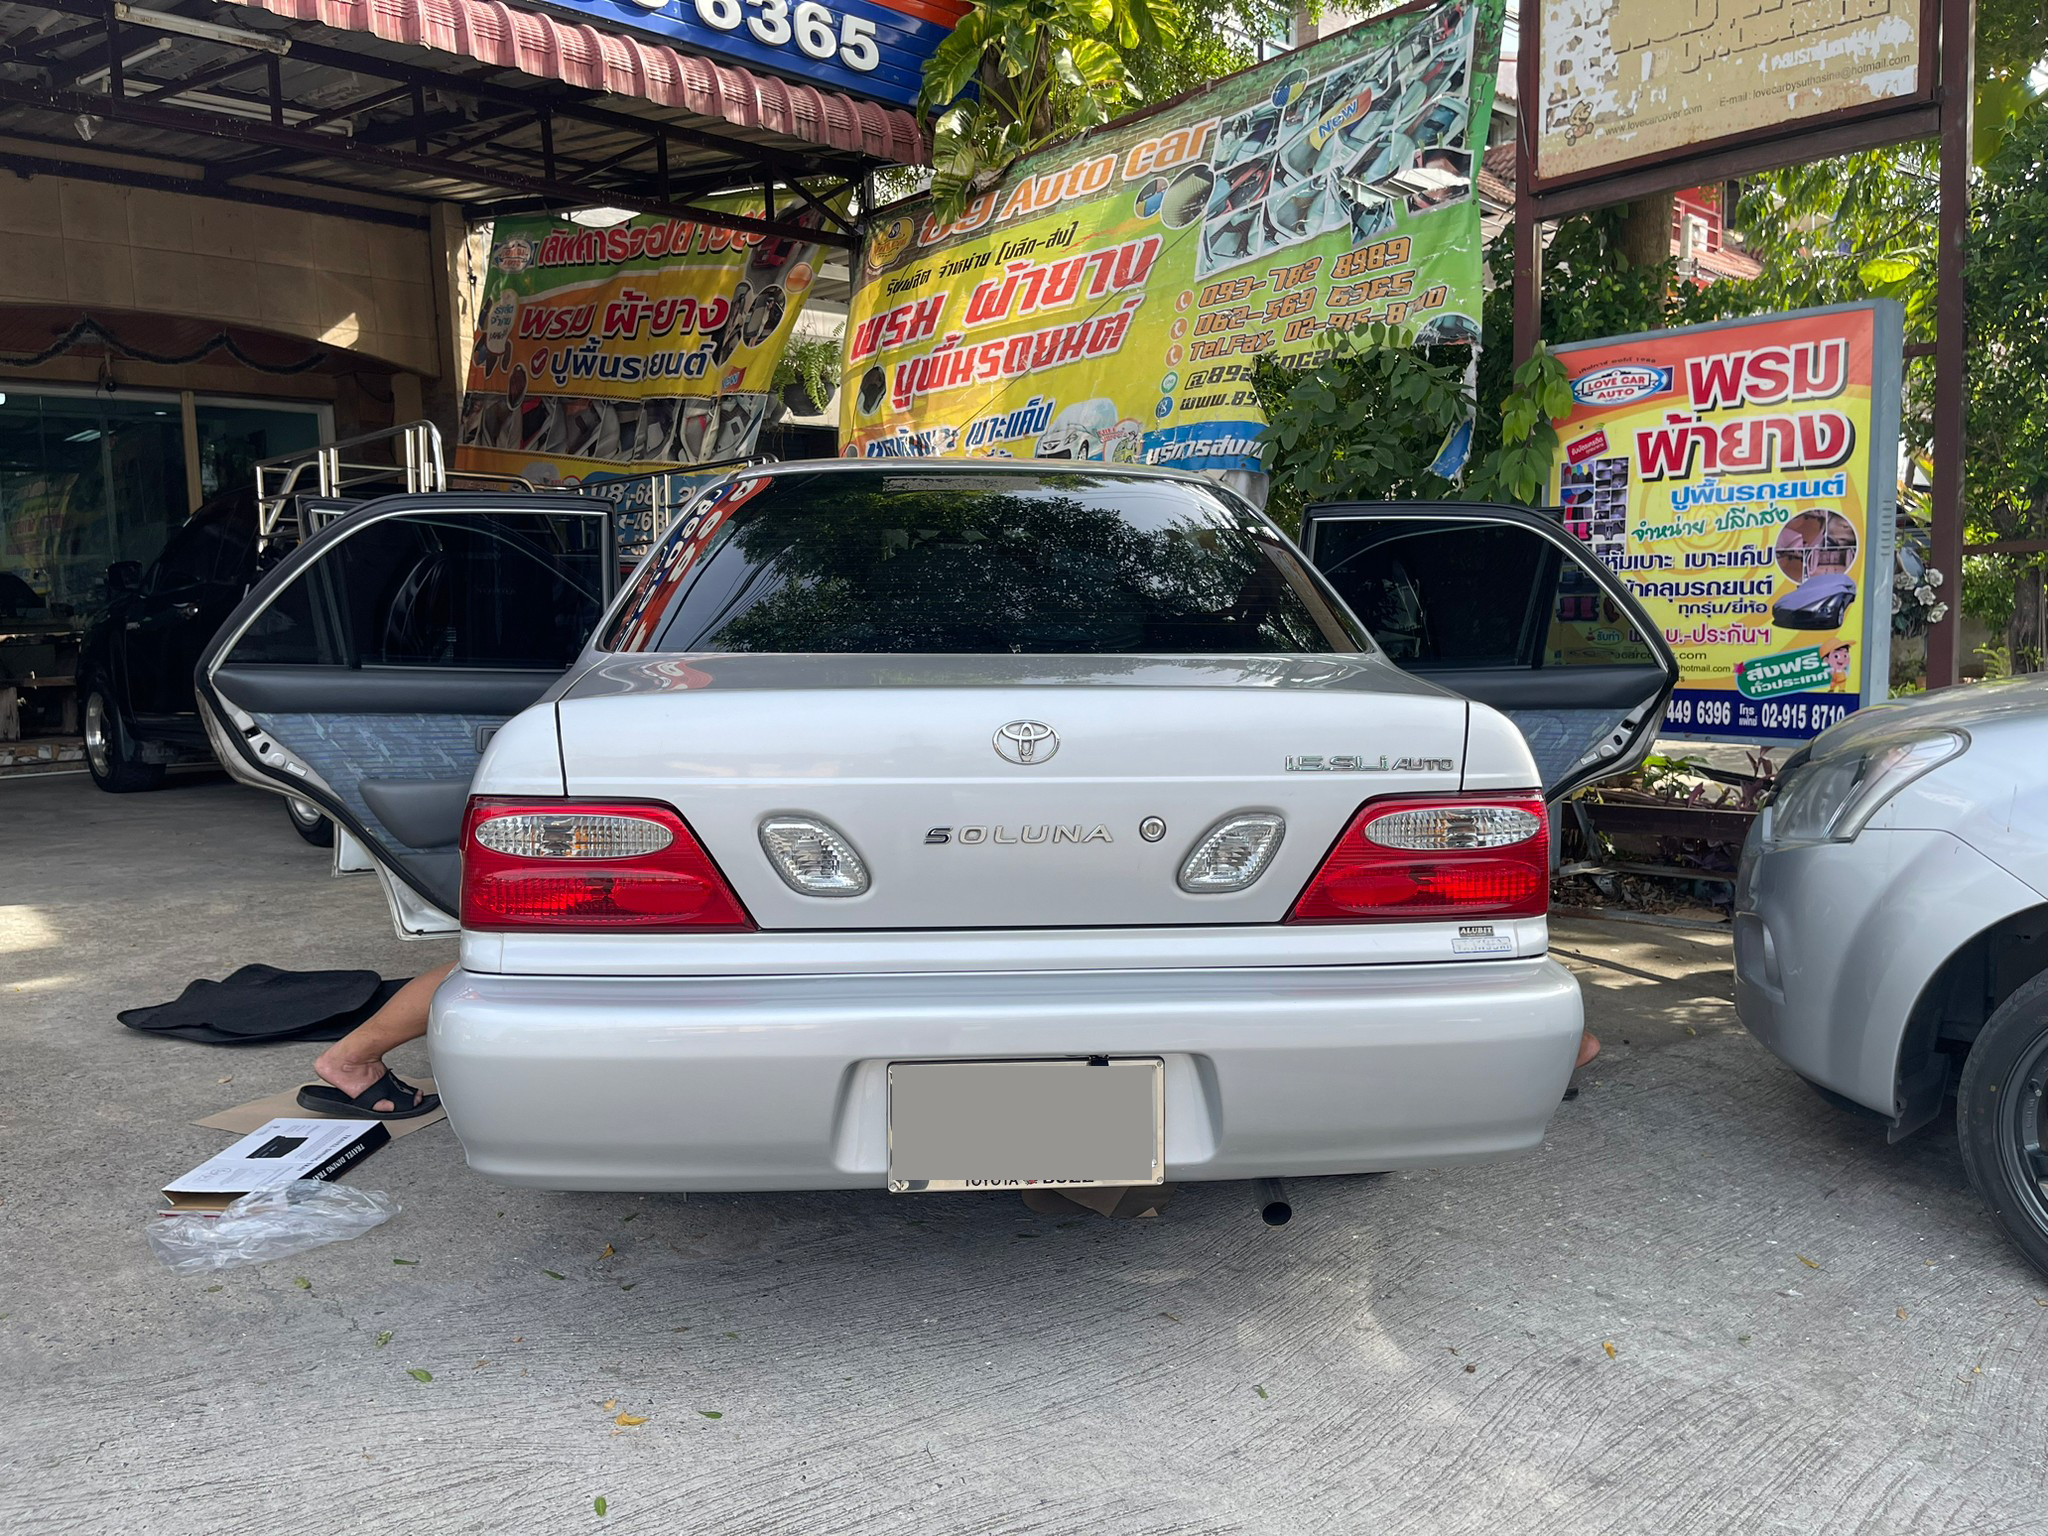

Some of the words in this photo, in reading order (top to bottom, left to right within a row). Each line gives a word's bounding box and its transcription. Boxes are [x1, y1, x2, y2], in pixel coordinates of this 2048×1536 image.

[995, 153, 1118, 223] Auto
[1121, 116, 1221, 182] car
[1199, 257, 1322, 308] 093-782
[1330, 235, 1412, 279] 8989
[850, 290, 948, 365] พรม
[963, 233, 1165, 328] ผ้ายาง
[1193, 286, 1318, 336] 062-569
[519, 302, 598, 340] พรม
[891, 294, 1146, 412] ปูพื้นรถยนต์
[1588, 377, 1618, 391] LOVE
[1621, 376, 1646, 385] CAR
[1597, 388, 1635, 399] AUTO
[1685, 338, 1847, 412] พรม
[1633, 409, 1854, 481] ผ้ายาง
[1671, 473, 1847, 512] ปูพื้นรถยนต์
[1631, 515, 1705, 542] จำหน่าย
[1715, 502, 1790, 532] ปลีกส่ง
[1684, 544, 1773, 568] เบาะแค็ป
[1697, 700, 1732, 725] 6396
[1761, 702, 1807, 729] 02-915
[1811, 704, 1846, 730] 8710
[1392, 756, 1454, 771] AUTO
[923, 824, 1114, 845] SOLUNA
